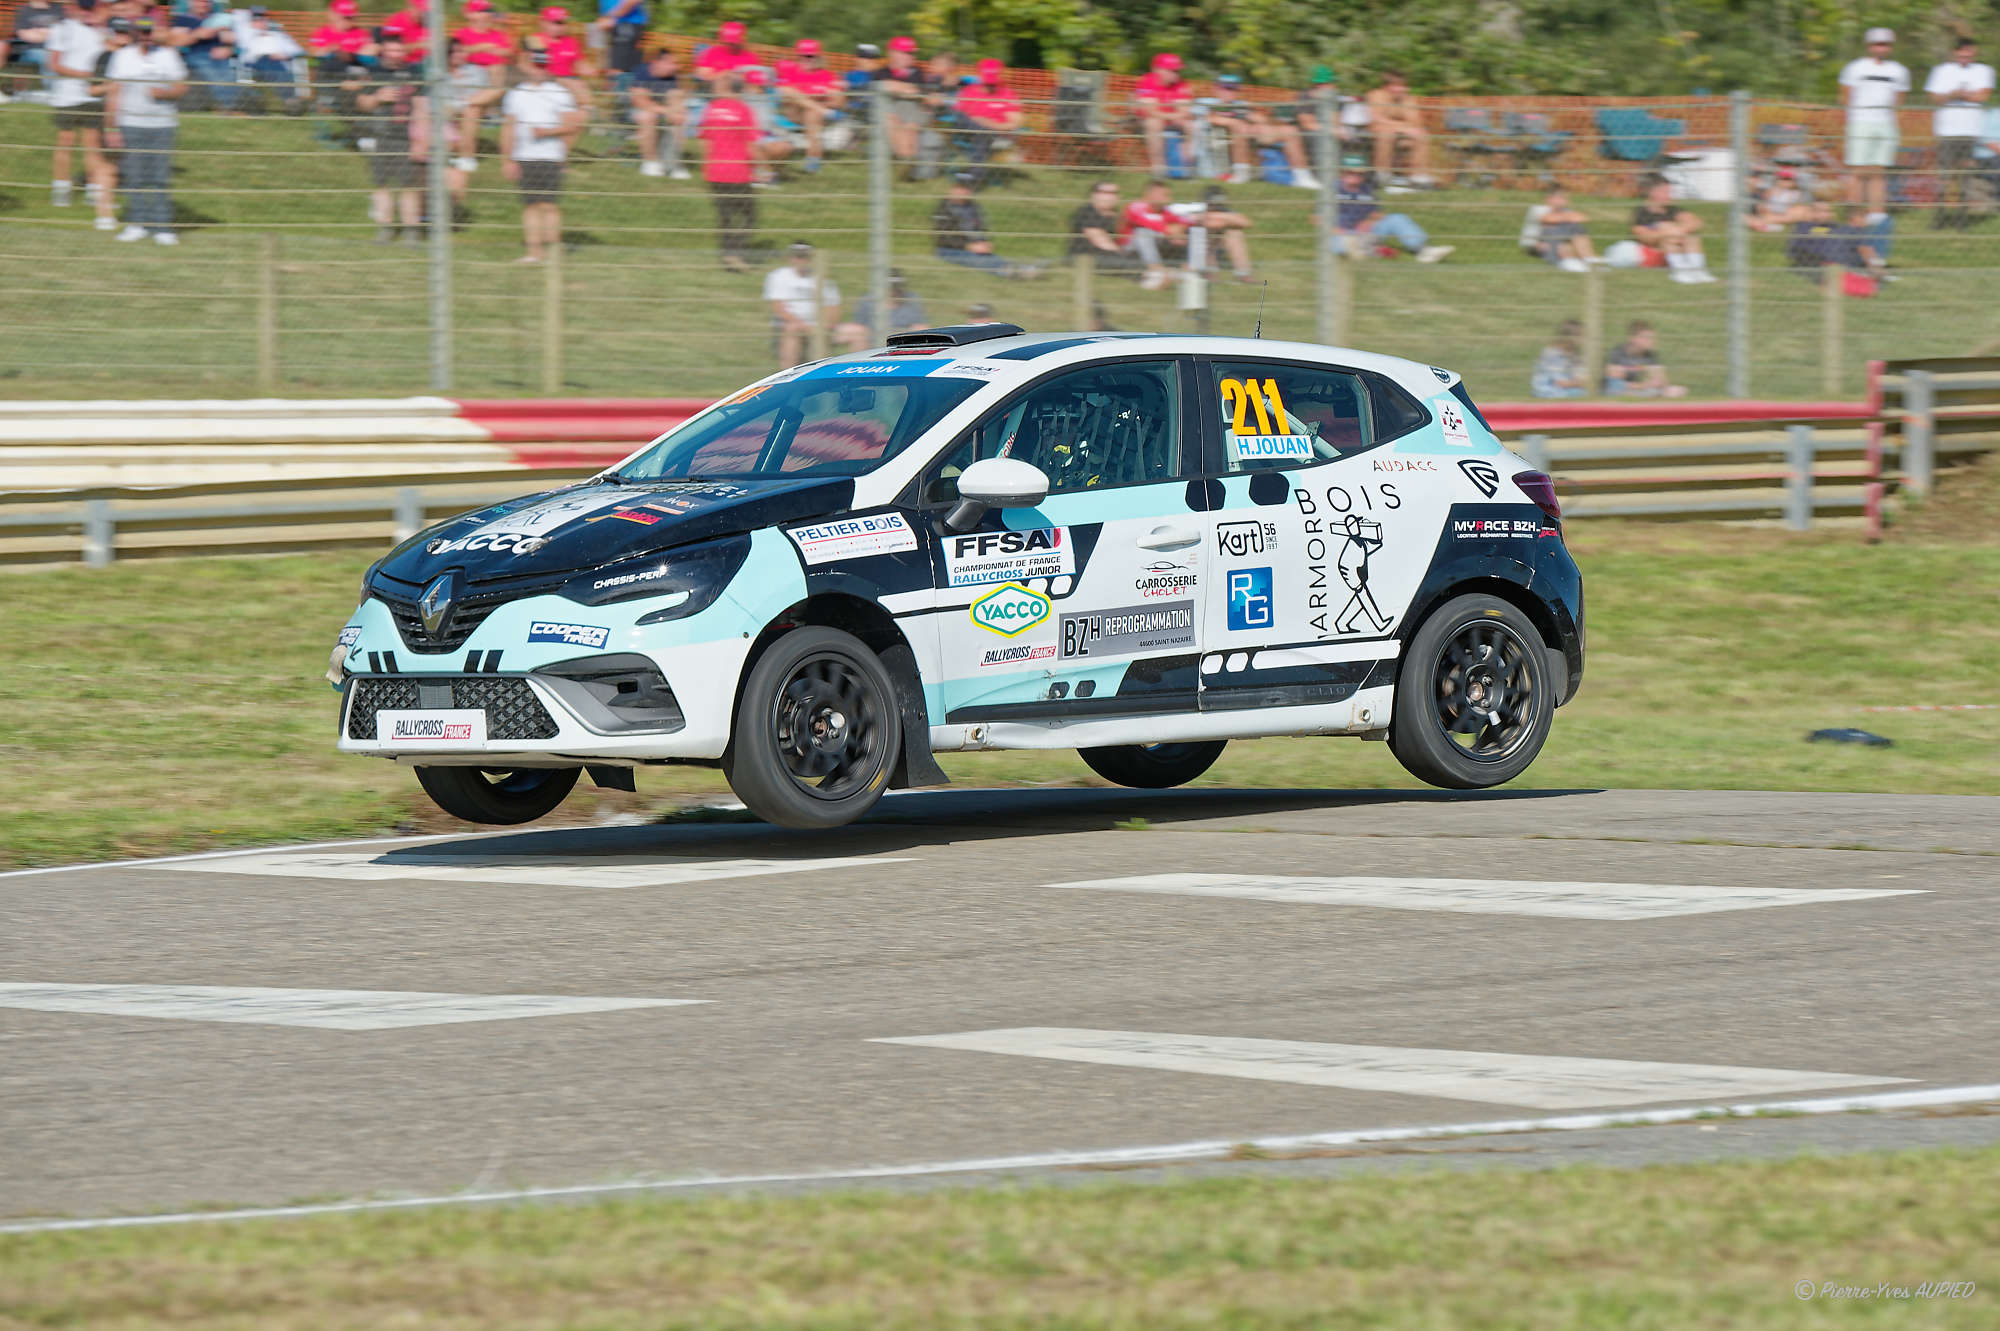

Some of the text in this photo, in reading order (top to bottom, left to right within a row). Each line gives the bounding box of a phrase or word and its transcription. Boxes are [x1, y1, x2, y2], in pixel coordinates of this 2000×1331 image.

[837, 365, 900, 375] JOUAN
[1220, 378, 1291, 435] 211
[1236, 437, 1309, 455] H.JOUAN
[1294, 483, 1401, 515] BOIS
[795, 516, 903, 541] PELTIER BOIS
[1263, 522, 1277, 536] 56
[426, 533, 549, 555] YACCO
[955, 529, 1051, 559] FFSA
[1216, 528, 1260, 556] Kart
[953, 555, 1061, 574] CHAMPIONNAT DE FRANCE
[953, 565, 1061, 584] RALLYCROSS JUNIOR
[1135, 574, 1198, 590] CARROSSERIE
[1304, 518, 1328, 632] ARMOR
[1143, 586, 1187, 598] CHOLET
[981, 600, 1043, 621] YACCO
[531, 622, 609, 639] COOPER
[1062, 608, 1192, 658] BZH REPROGRAMMATION
[562, 634, 604, 647] TIRES
[1155, 638, 1170, 646] SAINT
[983, 645, 1056, 664] RALLYCROSS FRANCE
[394, 719, 472, 739] RALLYCROSS FRANCE
